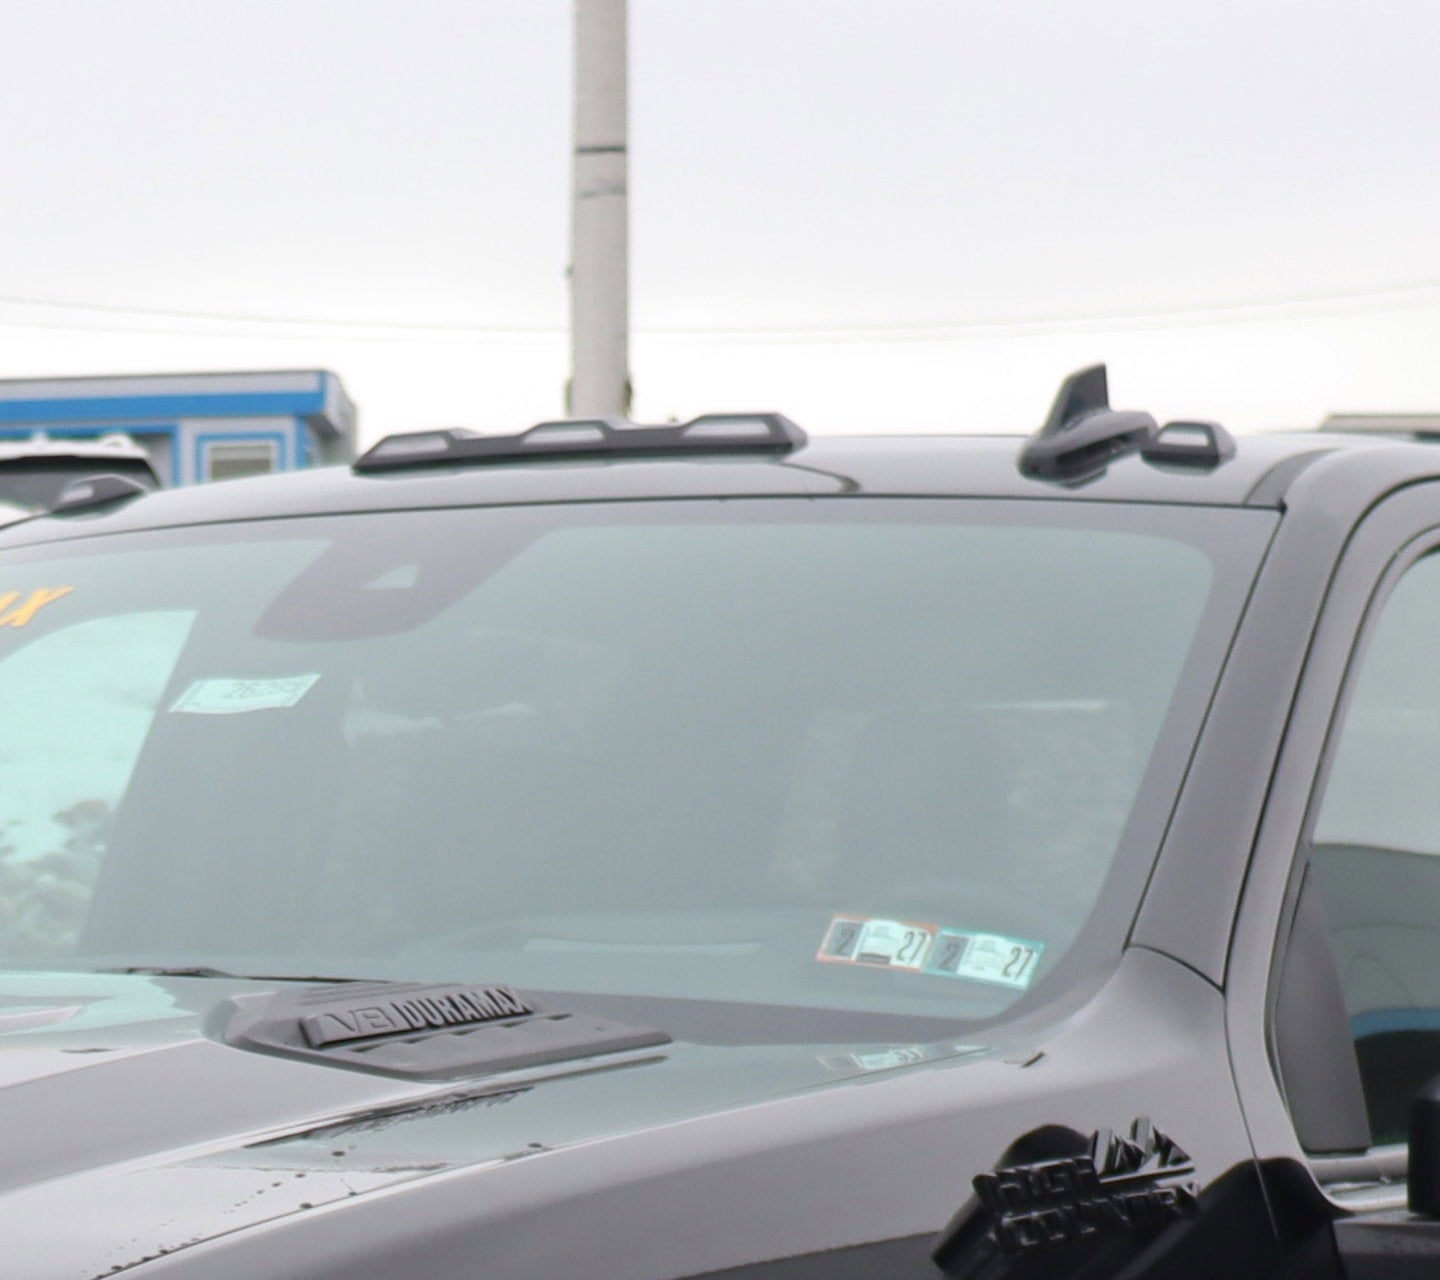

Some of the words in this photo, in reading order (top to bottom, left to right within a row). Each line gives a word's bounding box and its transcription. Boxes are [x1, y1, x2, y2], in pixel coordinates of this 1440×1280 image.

[895, 930, 929, 966] 27
[1001, 946, 1035, 981] 27
[395, 986, 534, 1029] DURAMAX
